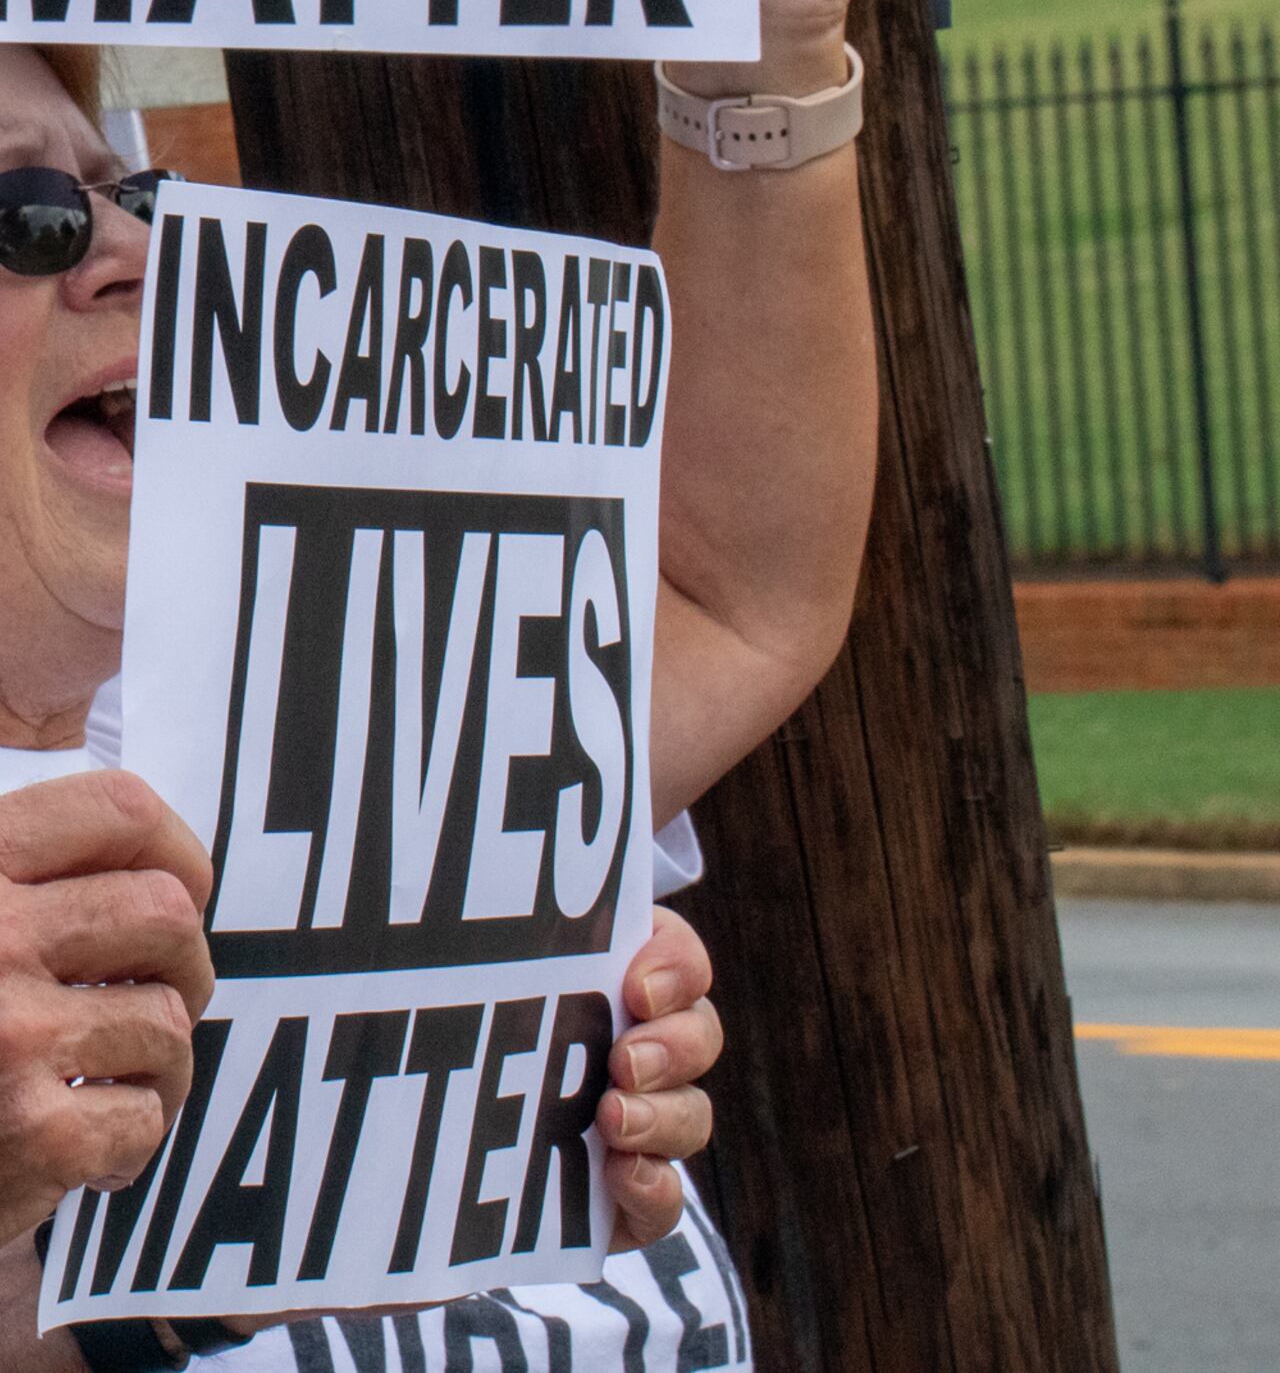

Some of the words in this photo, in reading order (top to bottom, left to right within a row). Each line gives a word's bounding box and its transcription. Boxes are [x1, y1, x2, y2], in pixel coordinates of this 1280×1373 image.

[148, 213, 664, 448] INCARCERATED
[211, 523, 627, 931] LIVES
[57, 989, 611, 1304] MATTER
